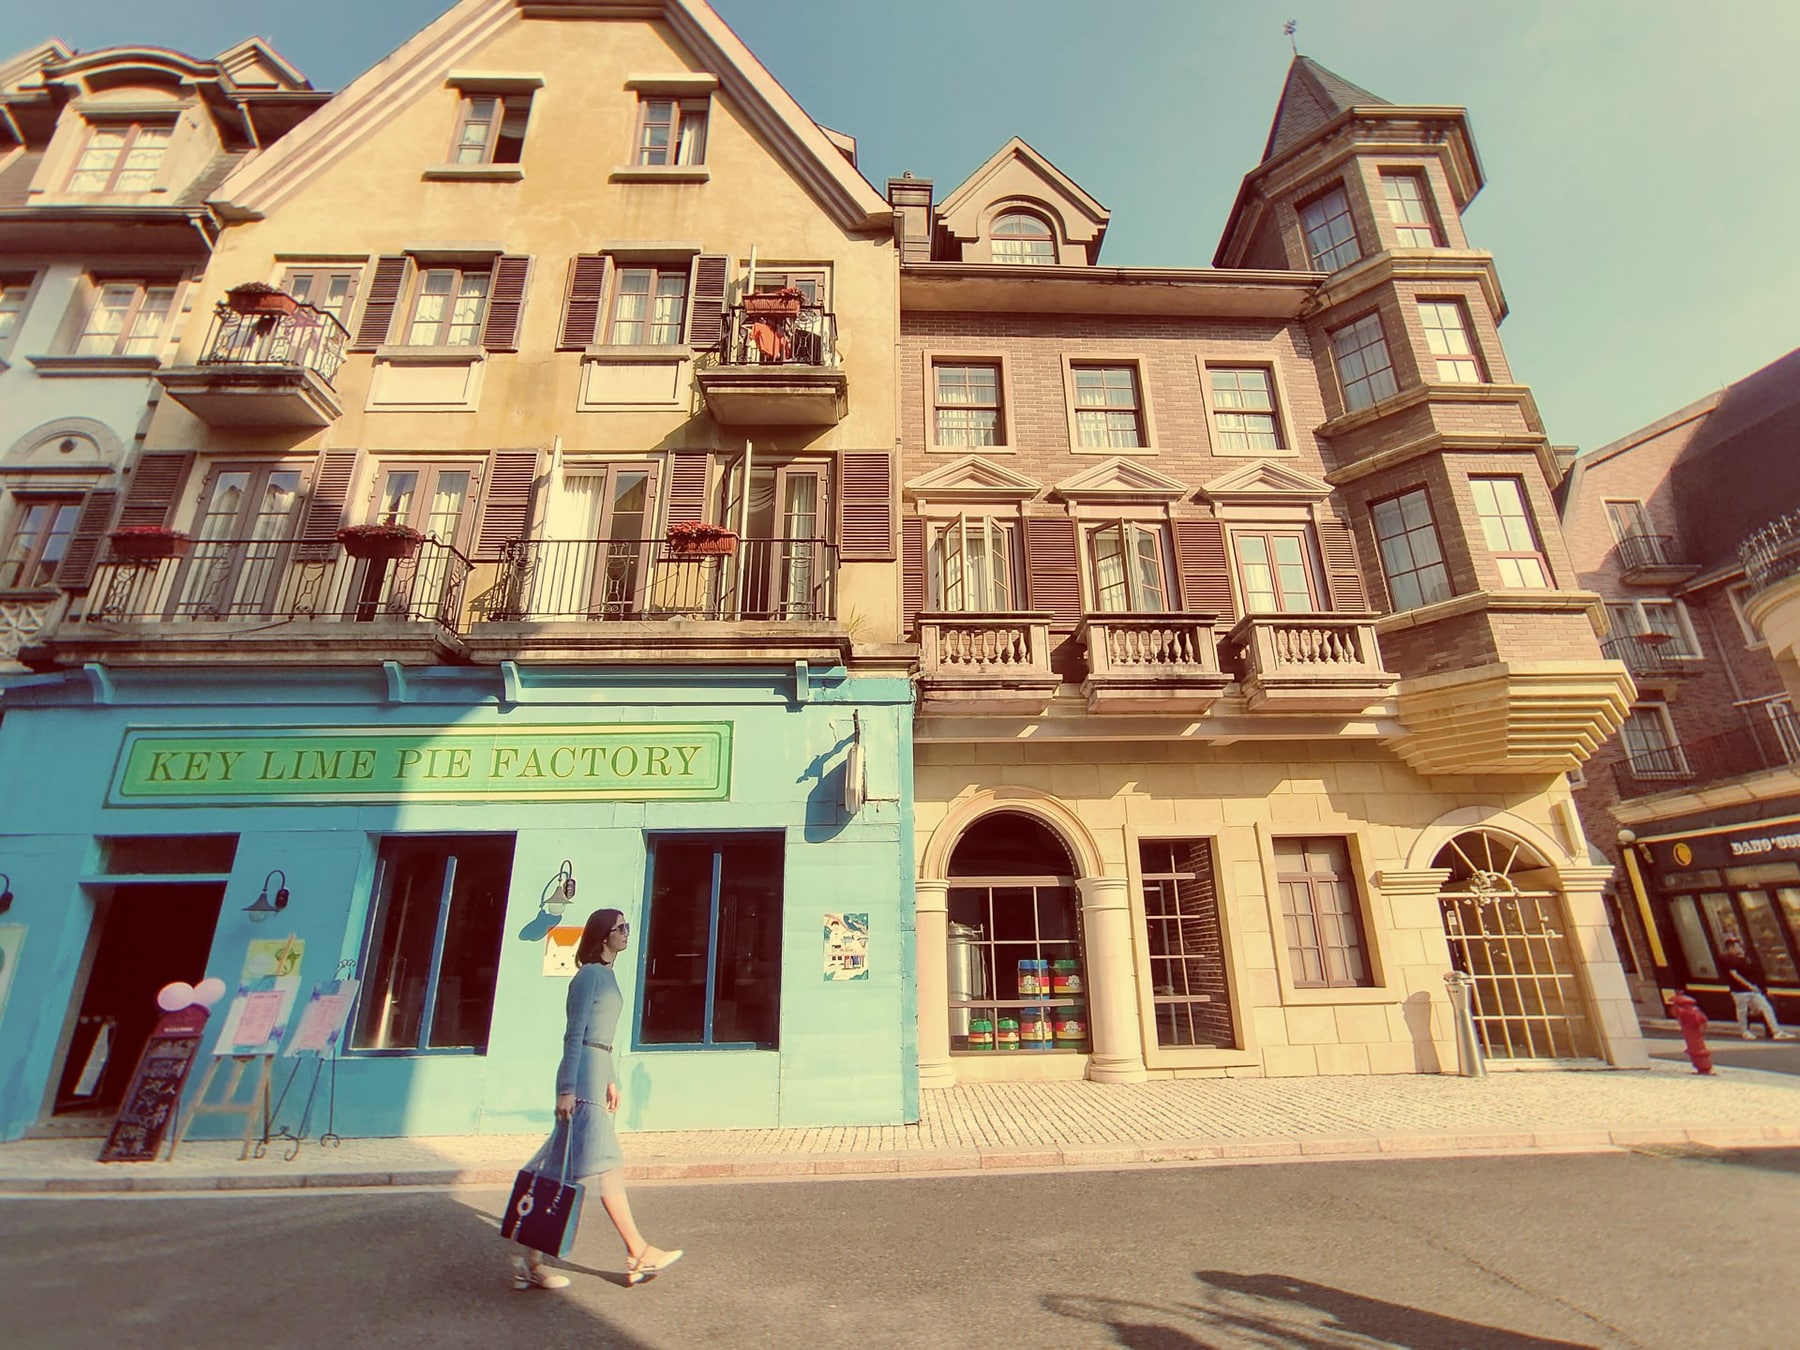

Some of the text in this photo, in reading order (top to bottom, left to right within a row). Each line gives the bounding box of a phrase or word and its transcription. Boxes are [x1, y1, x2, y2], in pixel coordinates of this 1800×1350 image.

[144, 745, 702, 782] KEY LIME PIE FACTORY
